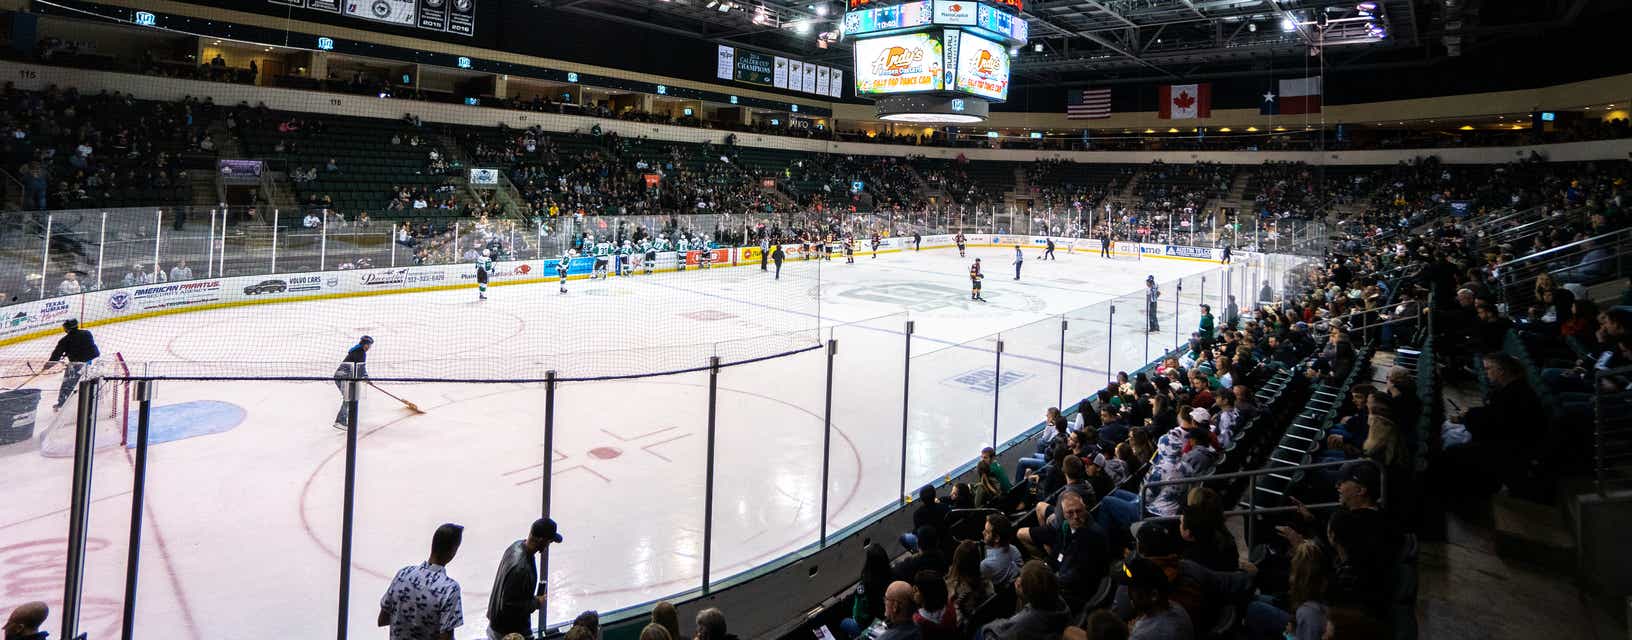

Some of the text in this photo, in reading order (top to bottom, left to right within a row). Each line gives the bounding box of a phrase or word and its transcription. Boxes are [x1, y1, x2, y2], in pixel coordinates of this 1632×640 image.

[871, 46, 924, 76] Andy's
[968, 49, 1002, 73] Andy's
[737, 62, 771, 73] CHAMPIONS
[134, 281, 220, 296] AMERICAN PARATUS
[145, 290, 178, 299] SECURITY
[41, 304, 69, 314] HUMANE
[46, 301, 65, 309] TEXAS
